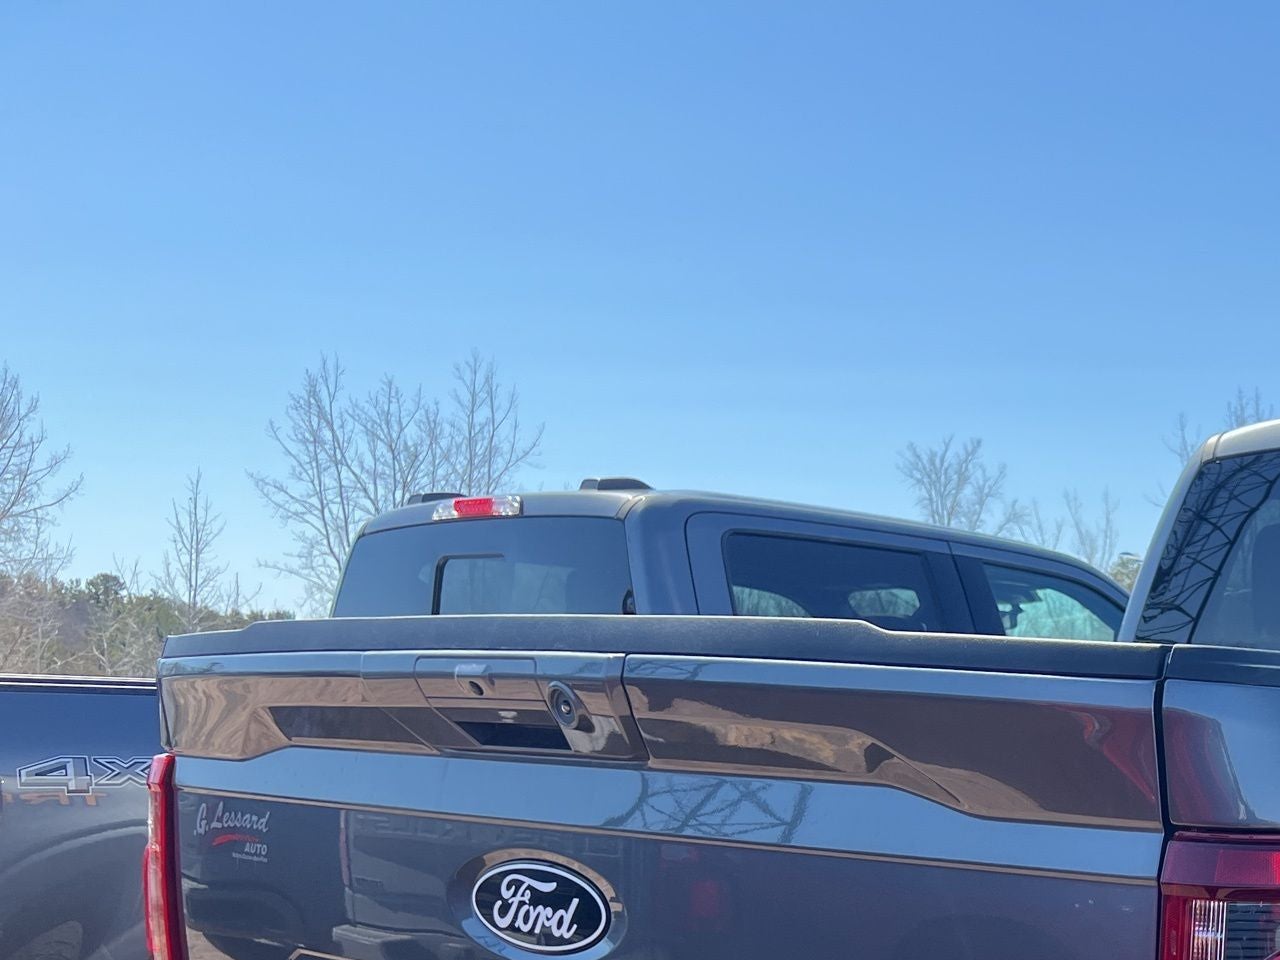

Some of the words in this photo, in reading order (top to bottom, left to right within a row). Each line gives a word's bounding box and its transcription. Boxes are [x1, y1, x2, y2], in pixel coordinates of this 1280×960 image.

[17, 755, 152, 795] 4X
[211, 800, 270, 832] Lessard
[244, 842, 267, 855] AUTO
[493, 873, 579, 939] Ford
